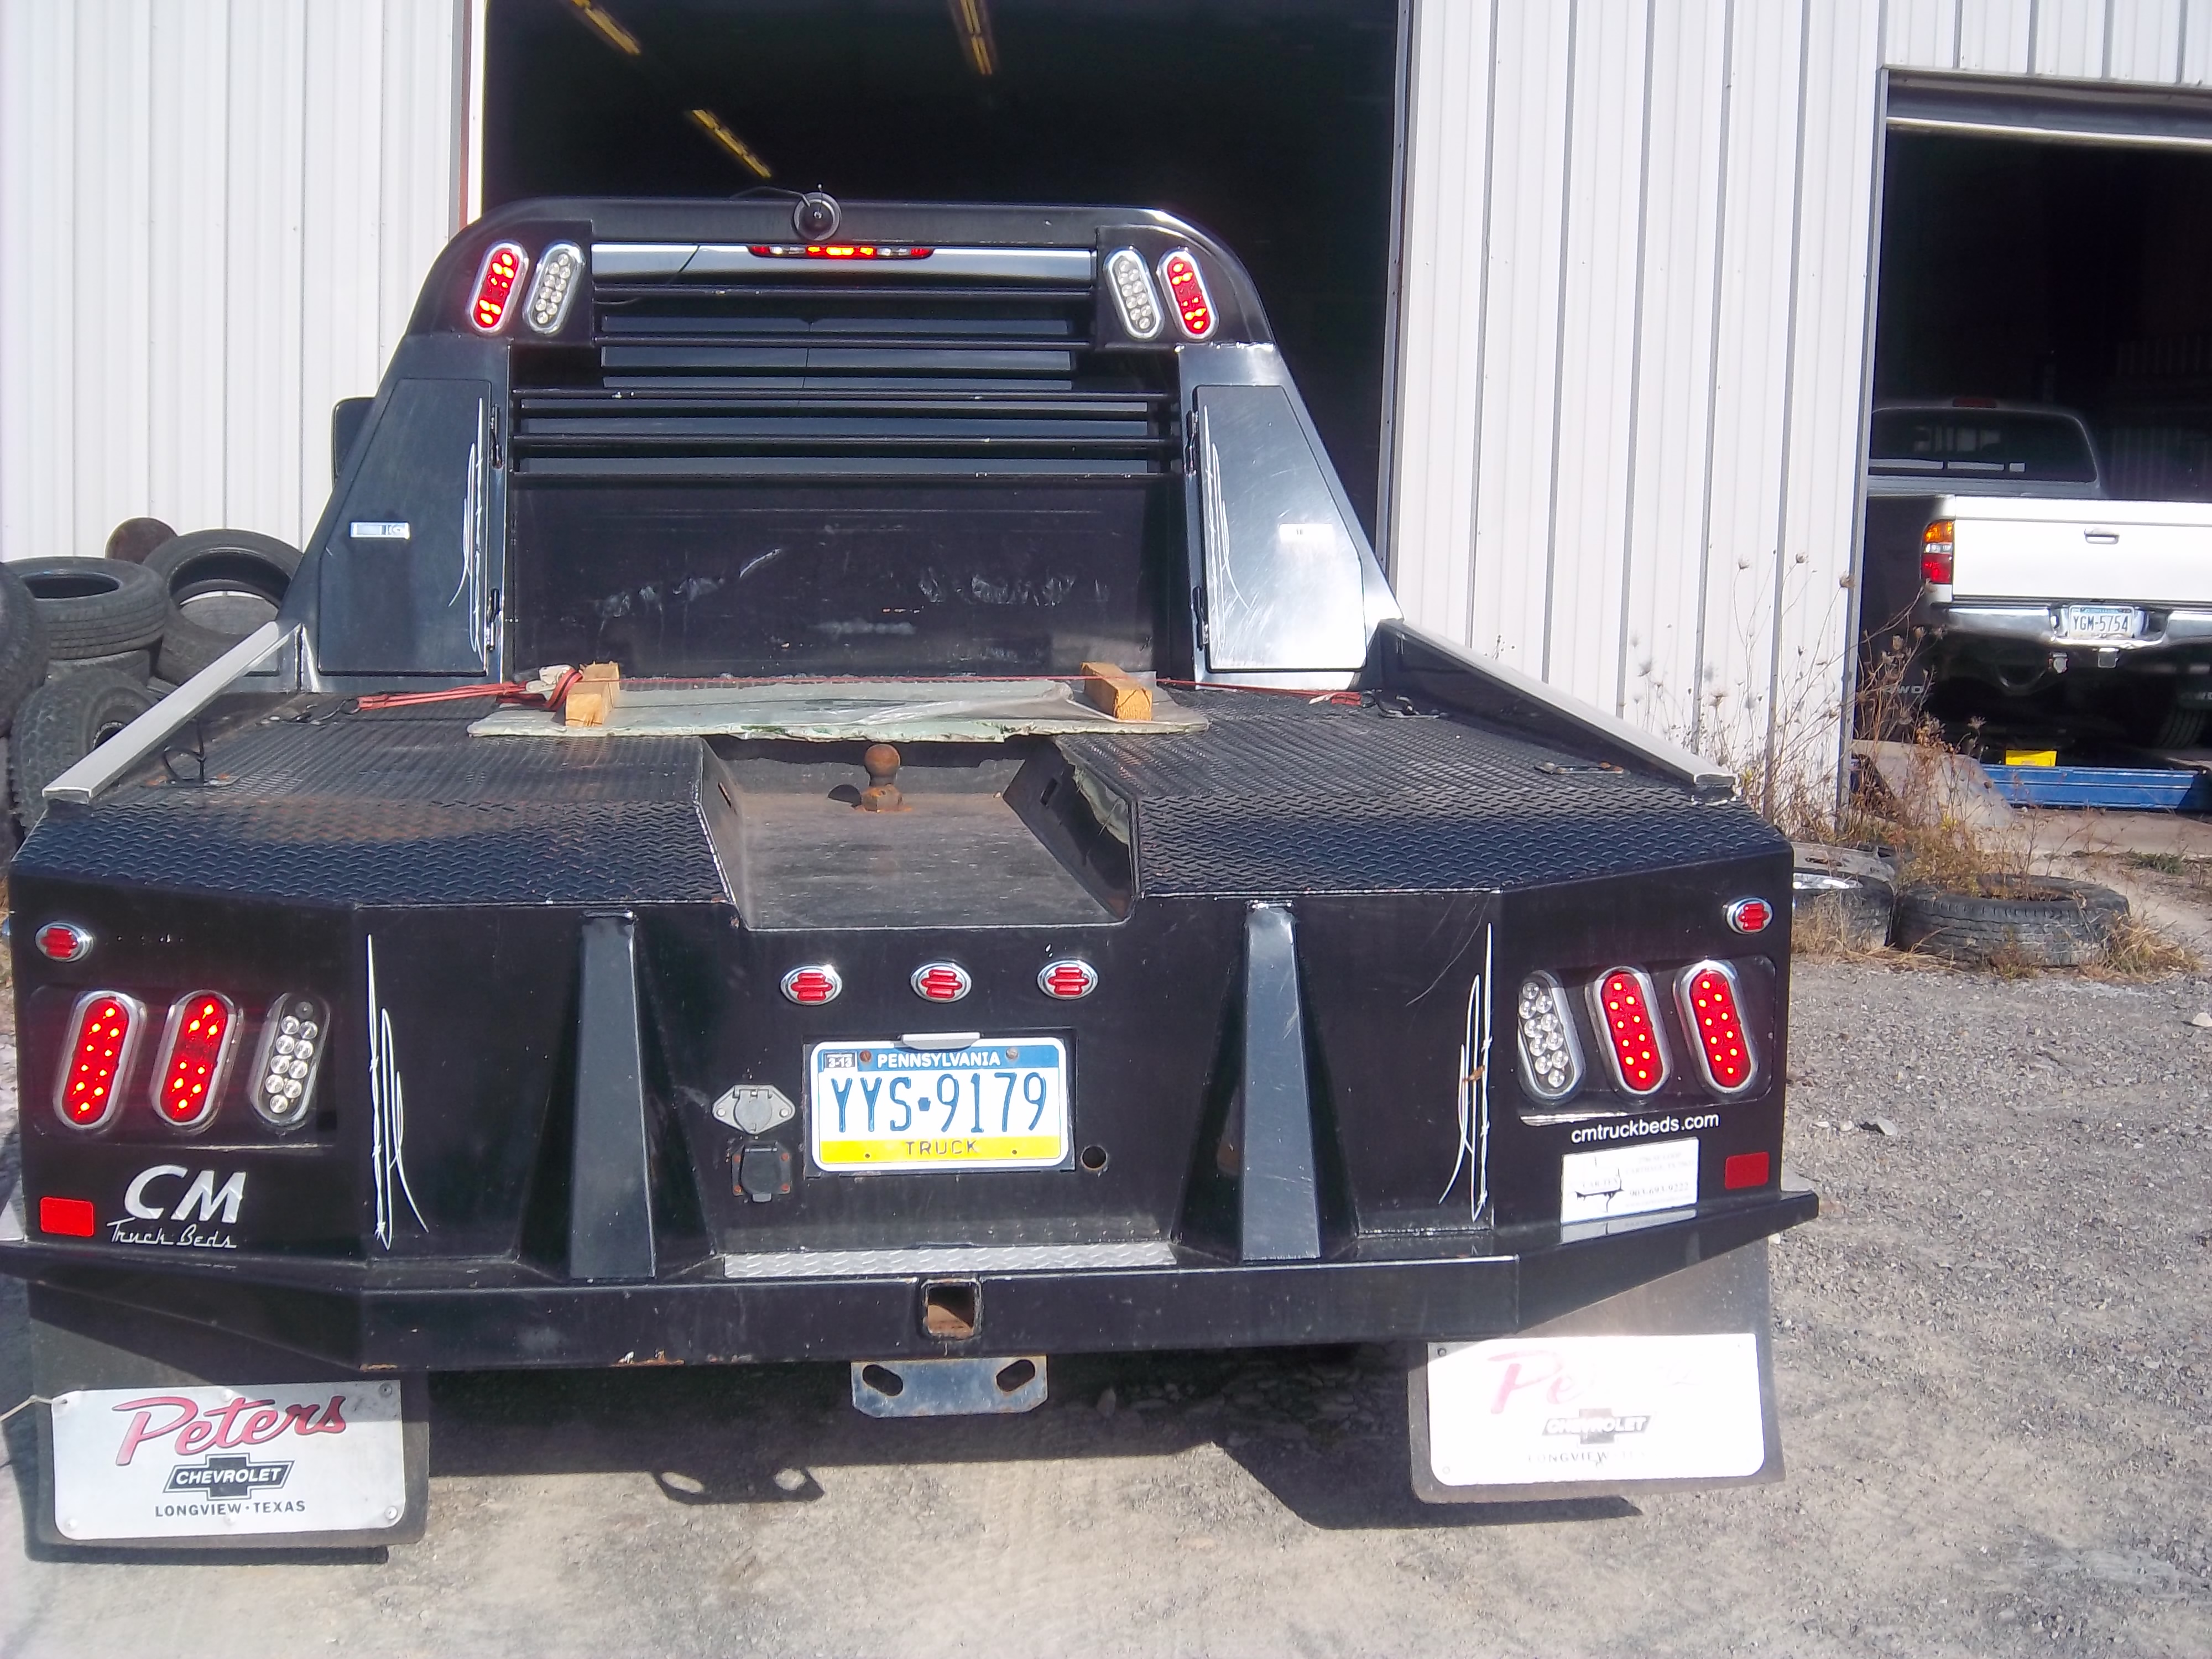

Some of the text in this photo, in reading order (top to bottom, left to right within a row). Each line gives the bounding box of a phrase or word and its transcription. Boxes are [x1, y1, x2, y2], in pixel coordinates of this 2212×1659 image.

[2073, 615, 2128, 632] YGM-5754
[877, 1052, 1001, 1069] PENNSYLVANIA
[1571, 1113, 1720, 1144] cmtruckbeds.com
[905, 1140, 980, 1156] TRUCK
[124, 1164, 247, 1223] CM
[107, 1217, 237, 1249] Truck Beds
[112, 1395, 347, 1467] Peters
[1546, 1417, 1647, 1434] CHEVROLET
[175, 1467, 283, 1485] CHEVROLET
[155, 1500, 306, 1517] LONGVIEW TEXAS
